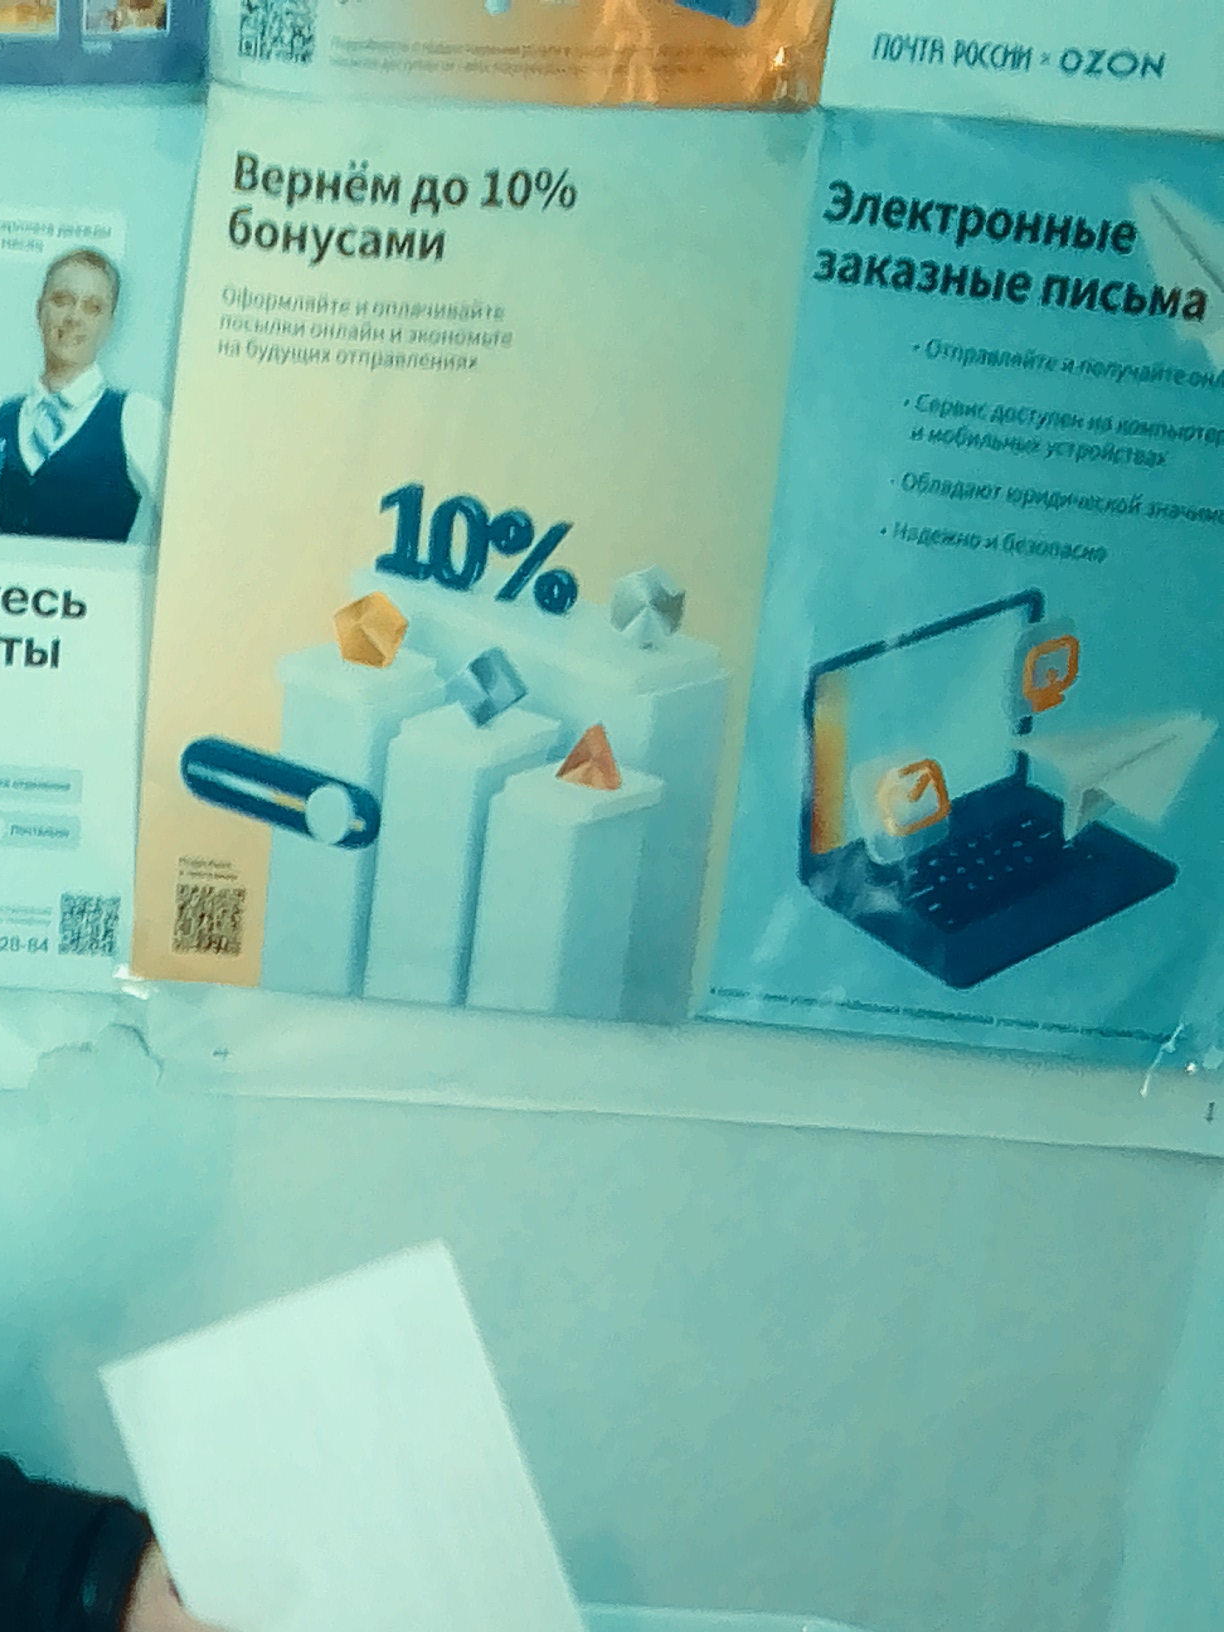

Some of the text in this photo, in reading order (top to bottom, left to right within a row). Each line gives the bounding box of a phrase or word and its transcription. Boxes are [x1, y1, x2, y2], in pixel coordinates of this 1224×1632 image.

[873, 32, 944, 64] ПОЧТА
[953, 38, 1033, 74] РОССИИ
[1059, 49, 1167, 80] OZON
[234, 150, 578, 216] Вернём до 10%
[228, 206, 447, 267] бонусами
[822, 180, 1138, 256] Электронные
[222, 285, 505, 321] Оформляйте и оплачивайте
[812, 248, 1208, 322] заказные письма
[218, 337, 478, 371] на будущих отправлениях
[219, 314, 305, 338] посылки
[310, 321, 385, 342] онлайн
[389, 329, 402, 344] и
[374, 482, 579, 617] 10%
